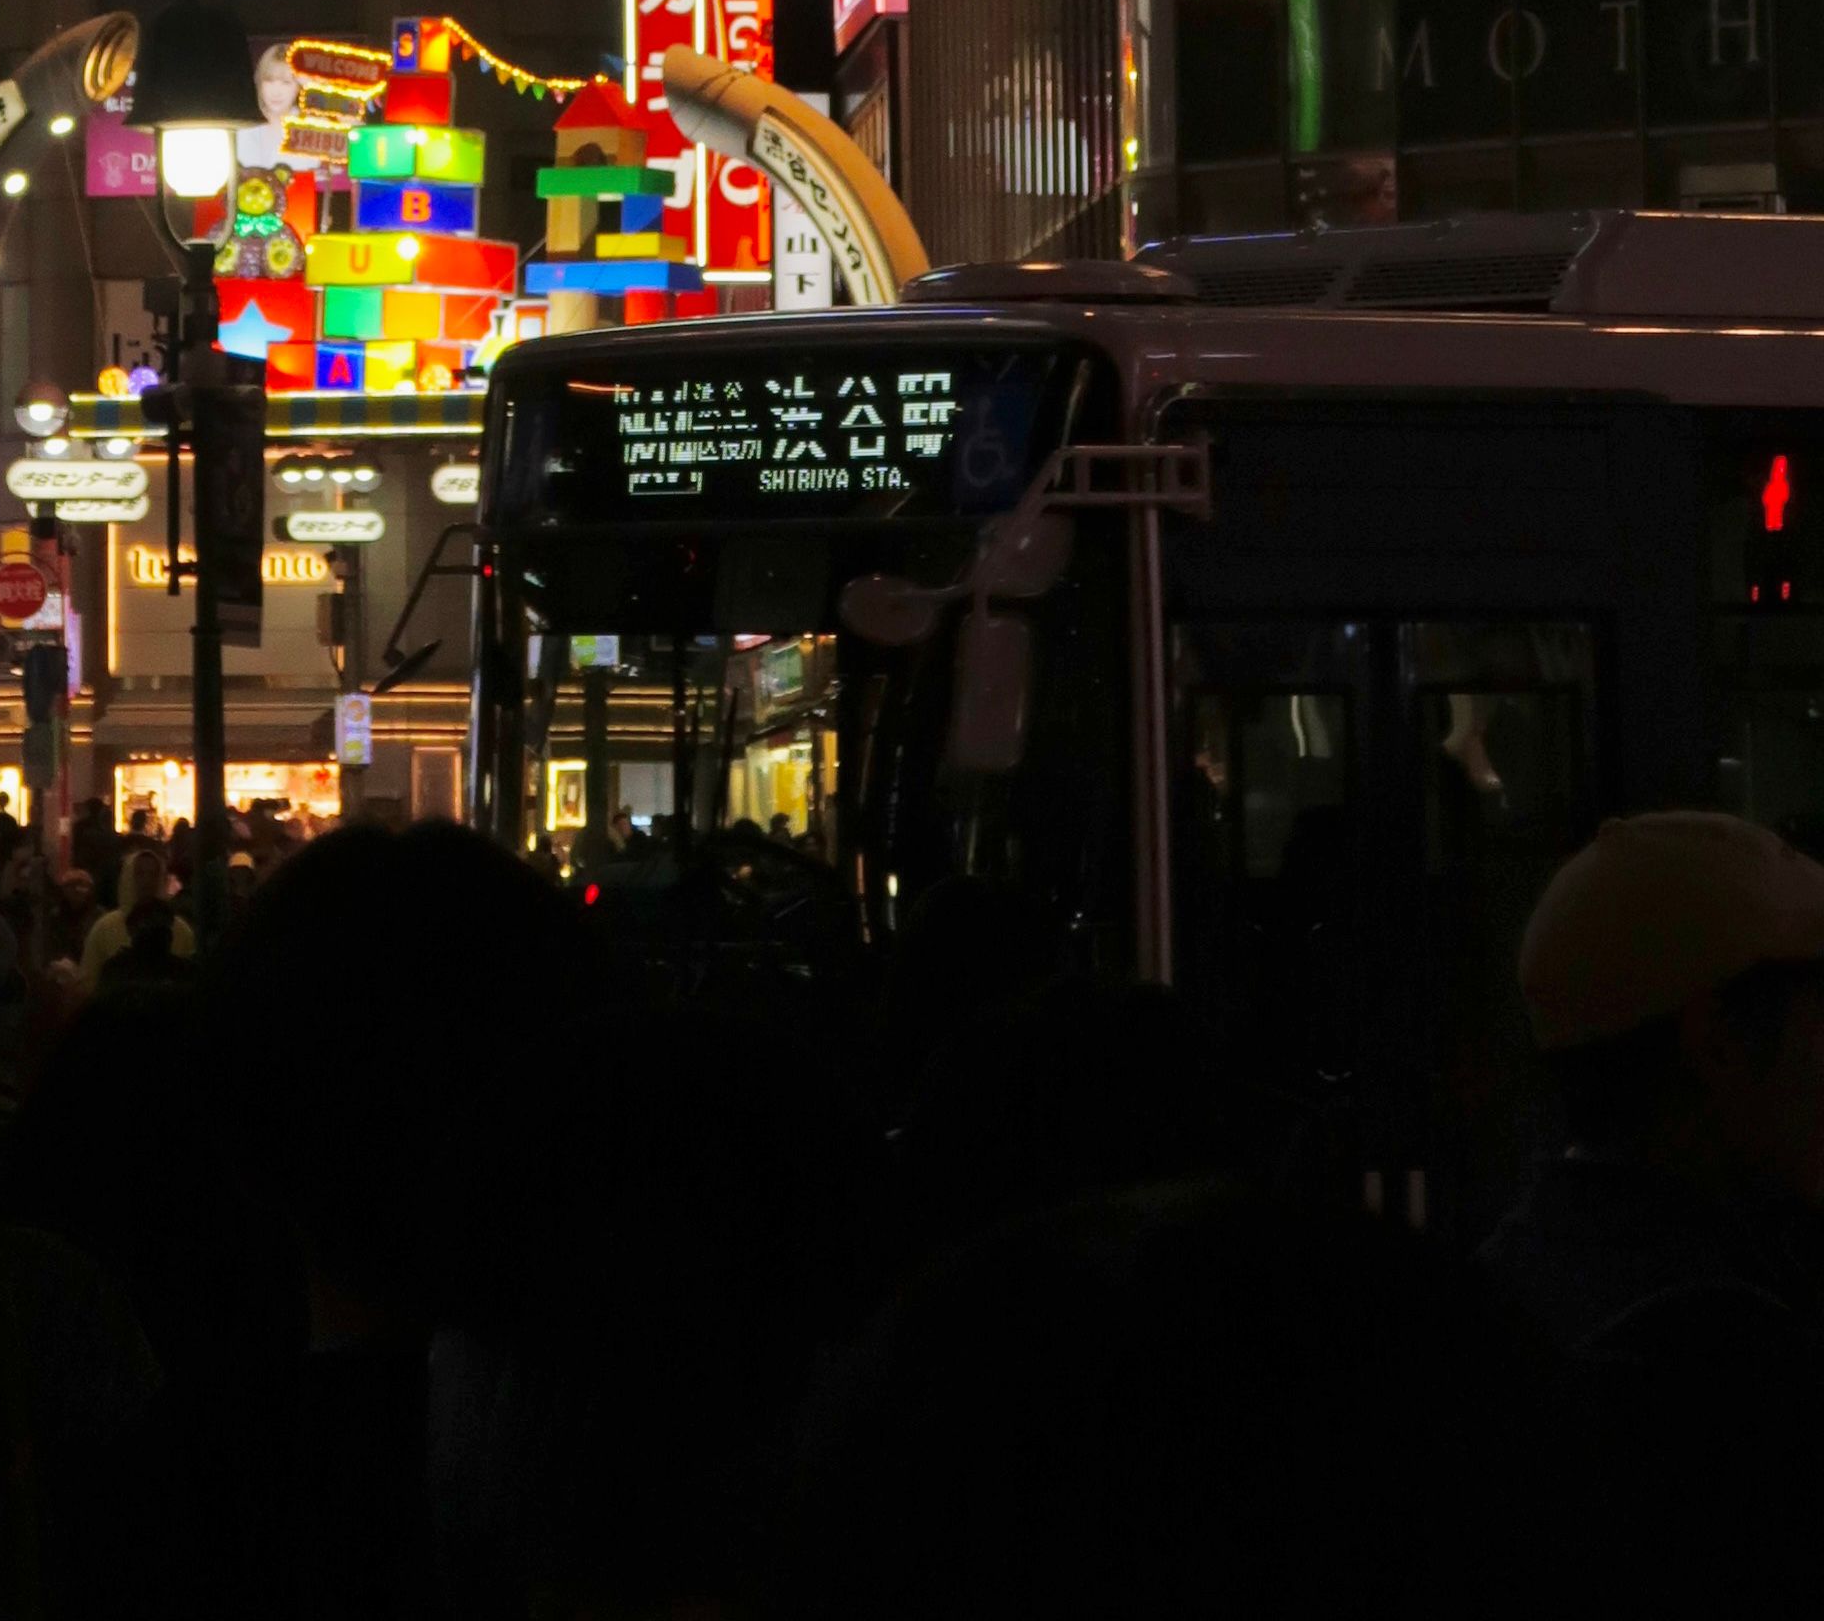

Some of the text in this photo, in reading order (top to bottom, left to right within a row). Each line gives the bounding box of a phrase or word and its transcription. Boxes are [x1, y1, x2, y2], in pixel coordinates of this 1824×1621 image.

[397, 32, 414, 57] S
[401, 190, 432, 223] B
[762, 126, 872, 304] 渋谷センター
[348, 243, 371, 275] U
[329, 354, 352, 384] A
[759, 466, 911, 493] SHIBUYA STA.
